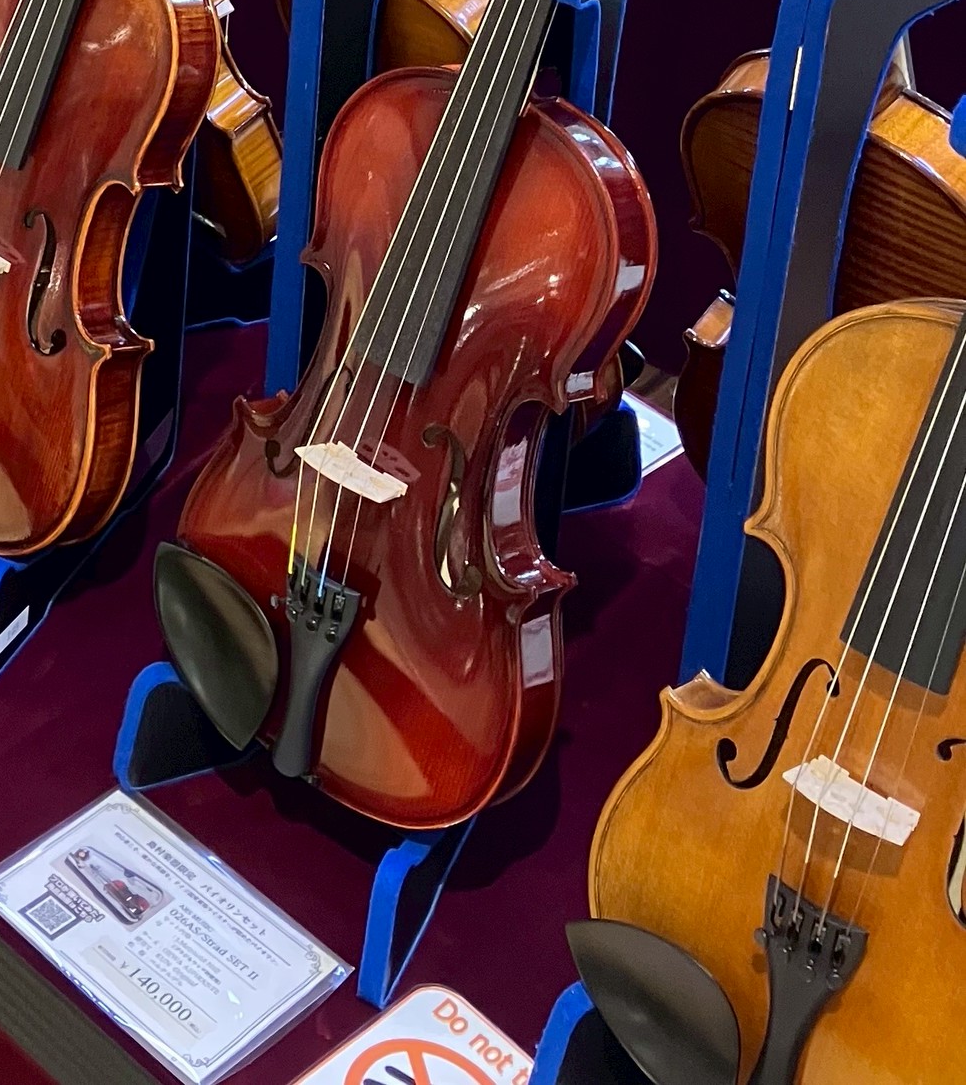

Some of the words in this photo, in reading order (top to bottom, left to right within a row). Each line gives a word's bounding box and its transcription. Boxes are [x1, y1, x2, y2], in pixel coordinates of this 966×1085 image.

[169, 908, 228, 957] 026AS/Strad
[226, 953, 249, 972] SET
[200, 883, 267, 938] バイオリンセット
[433, 997, 469, 1035] Do
[469, 1032, 513, 1076] not
